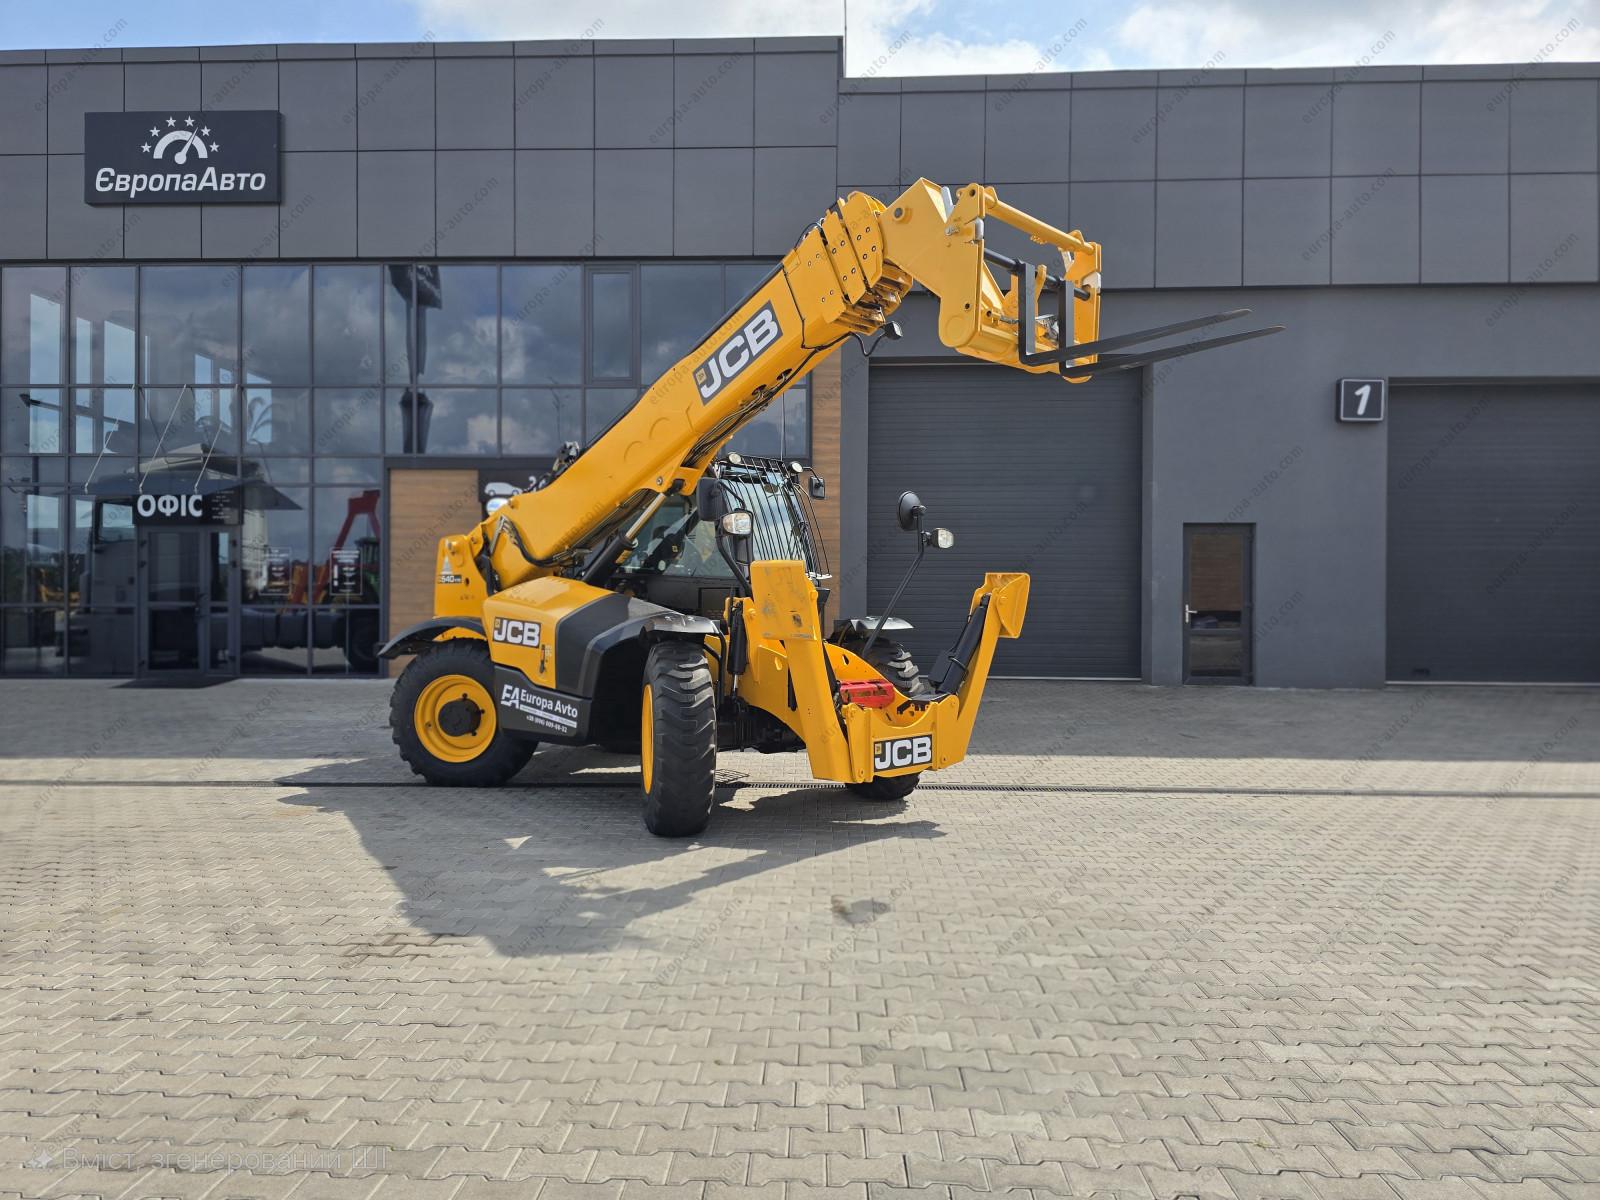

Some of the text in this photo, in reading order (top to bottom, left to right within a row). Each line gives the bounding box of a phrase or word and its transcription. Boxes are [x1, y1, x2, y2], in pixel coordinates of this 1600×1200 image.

[95, 167, 266, 198] ЄвропаАвто
[701, 309, 778, 398] JCB
[1354, 384, 1371, 415] 1
[137, 494, 203, 517] ОФІС
[494, 619, 540, 647] JCB
[520, 688, 553, 711] Europa
[554, 701, 578, 718] Avto
[875, 736, 932, 770] JCB
